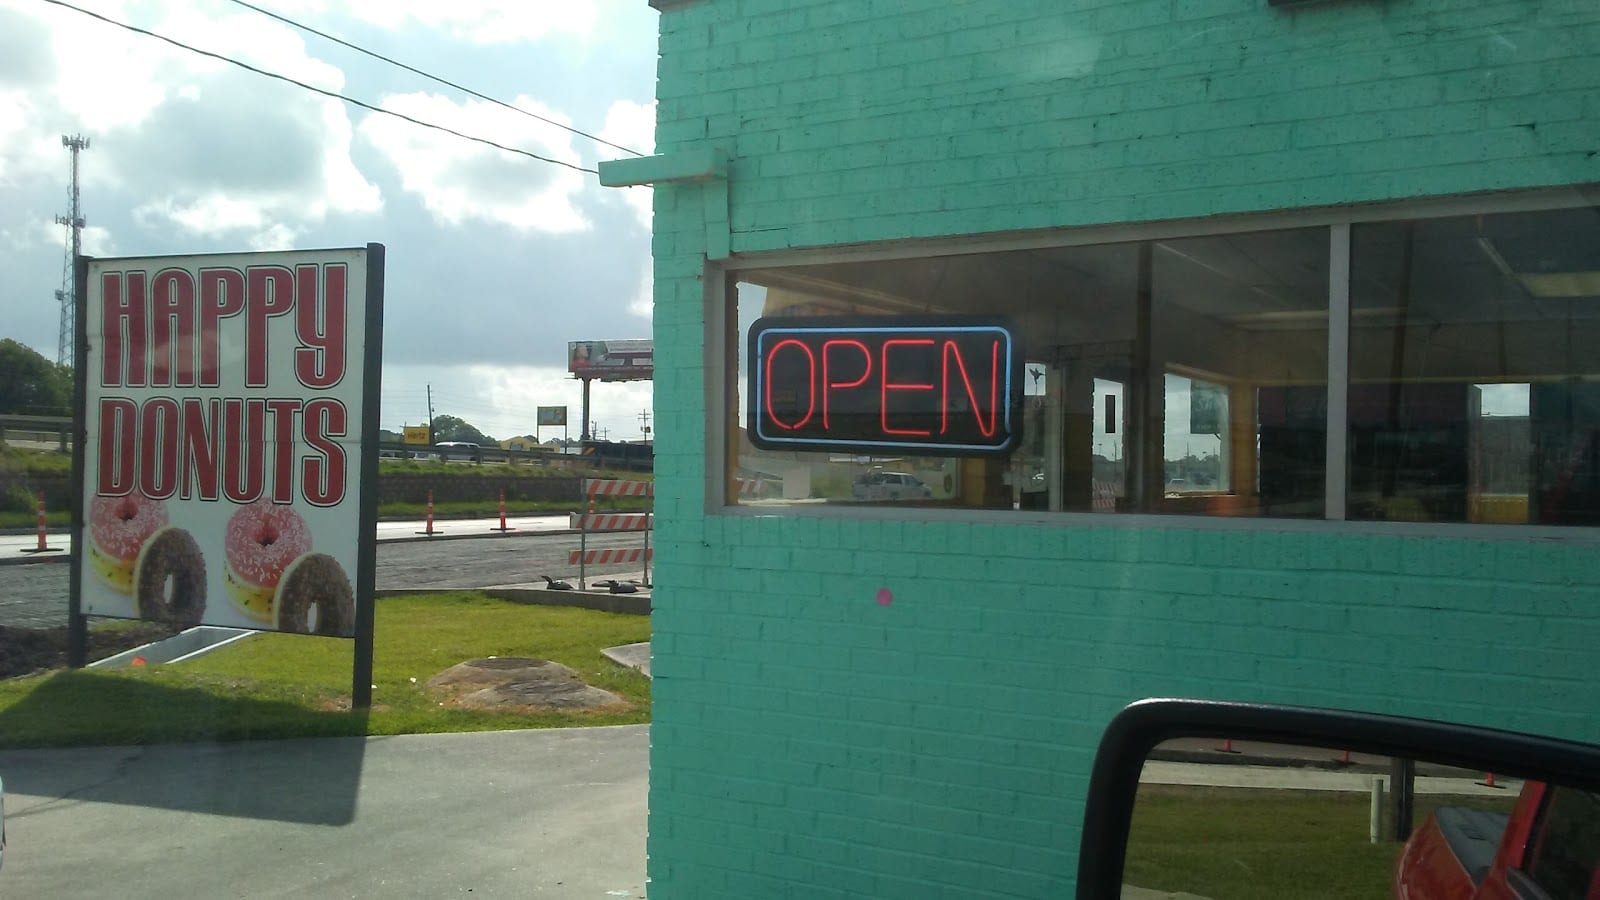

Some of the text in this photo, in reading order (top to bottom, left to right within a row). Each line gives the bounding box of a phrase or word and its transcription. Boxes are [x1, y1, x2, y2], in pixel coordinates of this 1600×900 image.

[101, 263, 348, 390] HAPPY
[765, 339, 999, 437] OPEN
[97, 396, 348, 508] DONUTS
